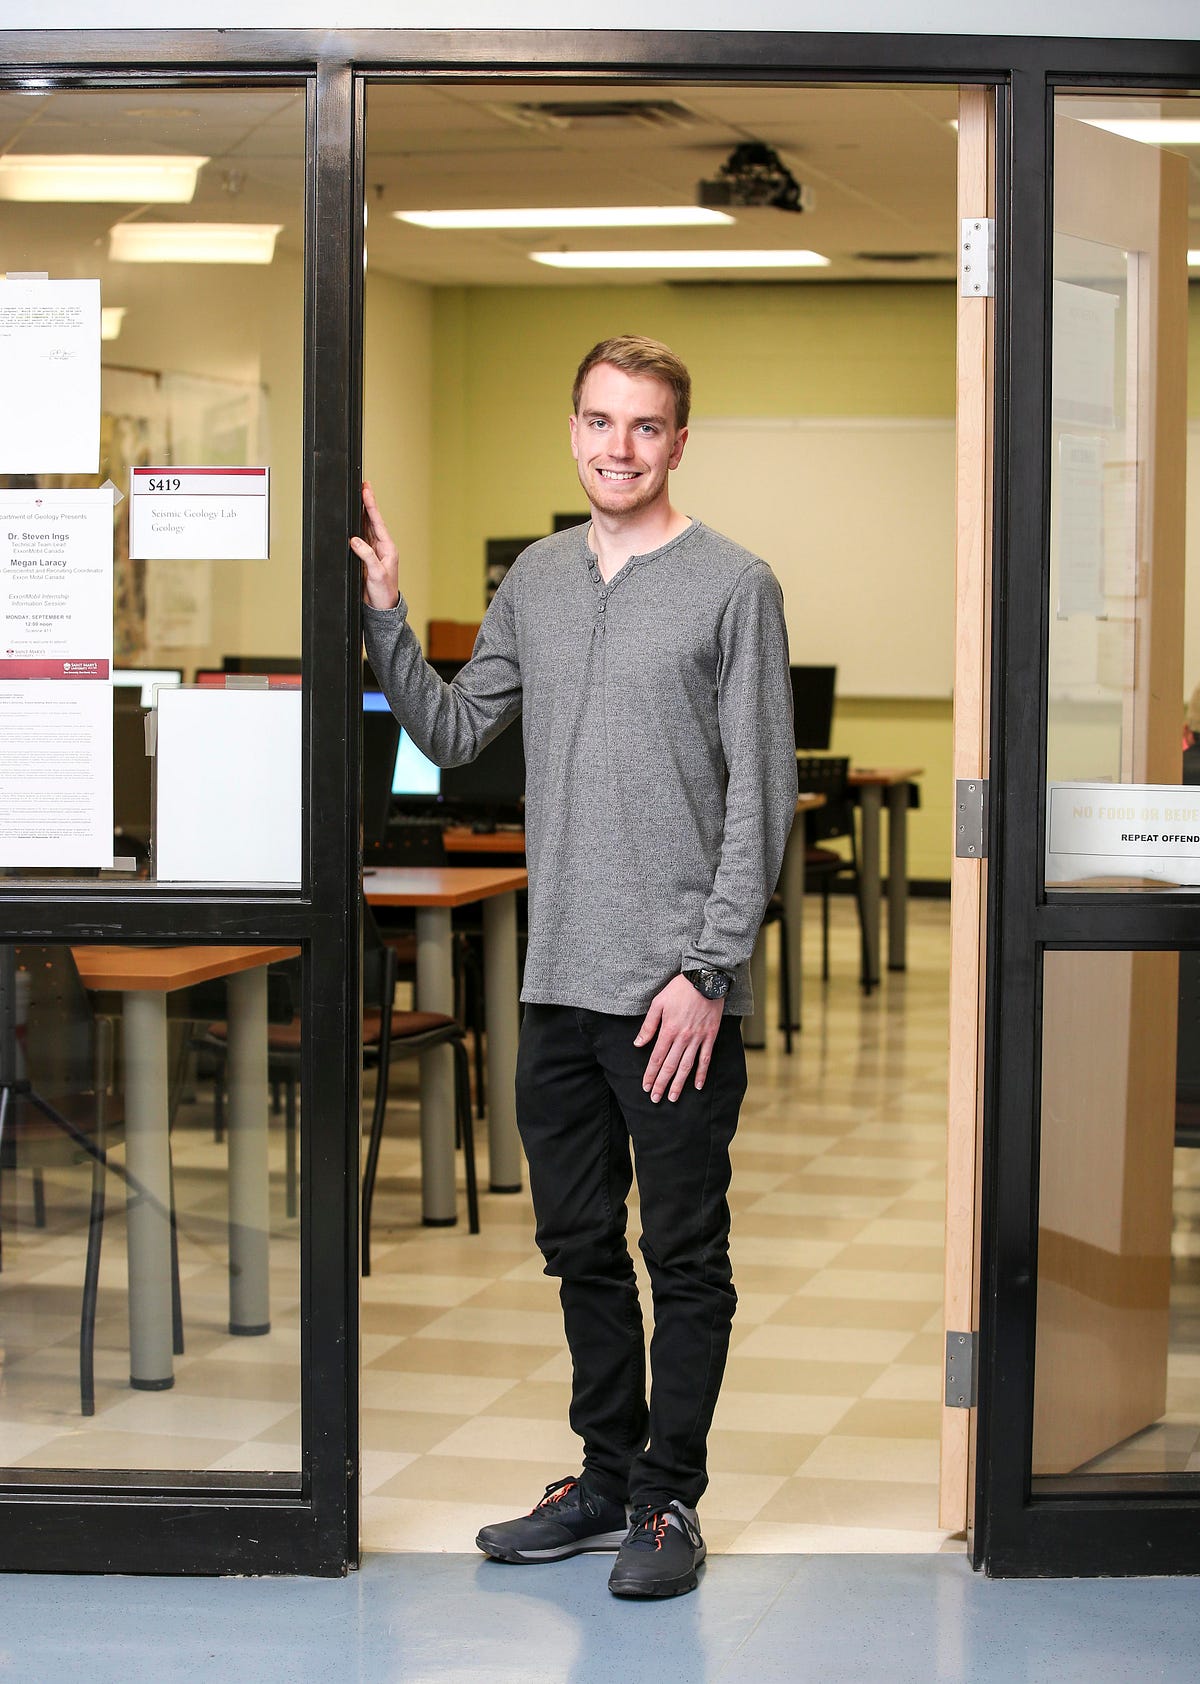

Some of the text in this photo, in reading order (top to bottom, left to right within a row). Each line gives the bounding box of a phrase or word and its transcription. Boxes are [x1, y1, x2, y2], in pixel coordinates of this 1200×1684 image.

[148, 478, 181, 491] S419
[34, 513, 59, 521] Geology
[151, 509, 237, 520] Seismic Geology Lab
[151, 523, 185, 535] Geology
[8, 532, 70, 542] Dr. Steven Ings
[10, 559, 67, 568] Megan Laracy
[1072, 806, 1093, 818] NO
[1099, 807, 1136, 820] FOOD
[1121, 833, 1200, 843] REPEAT OFFEND
